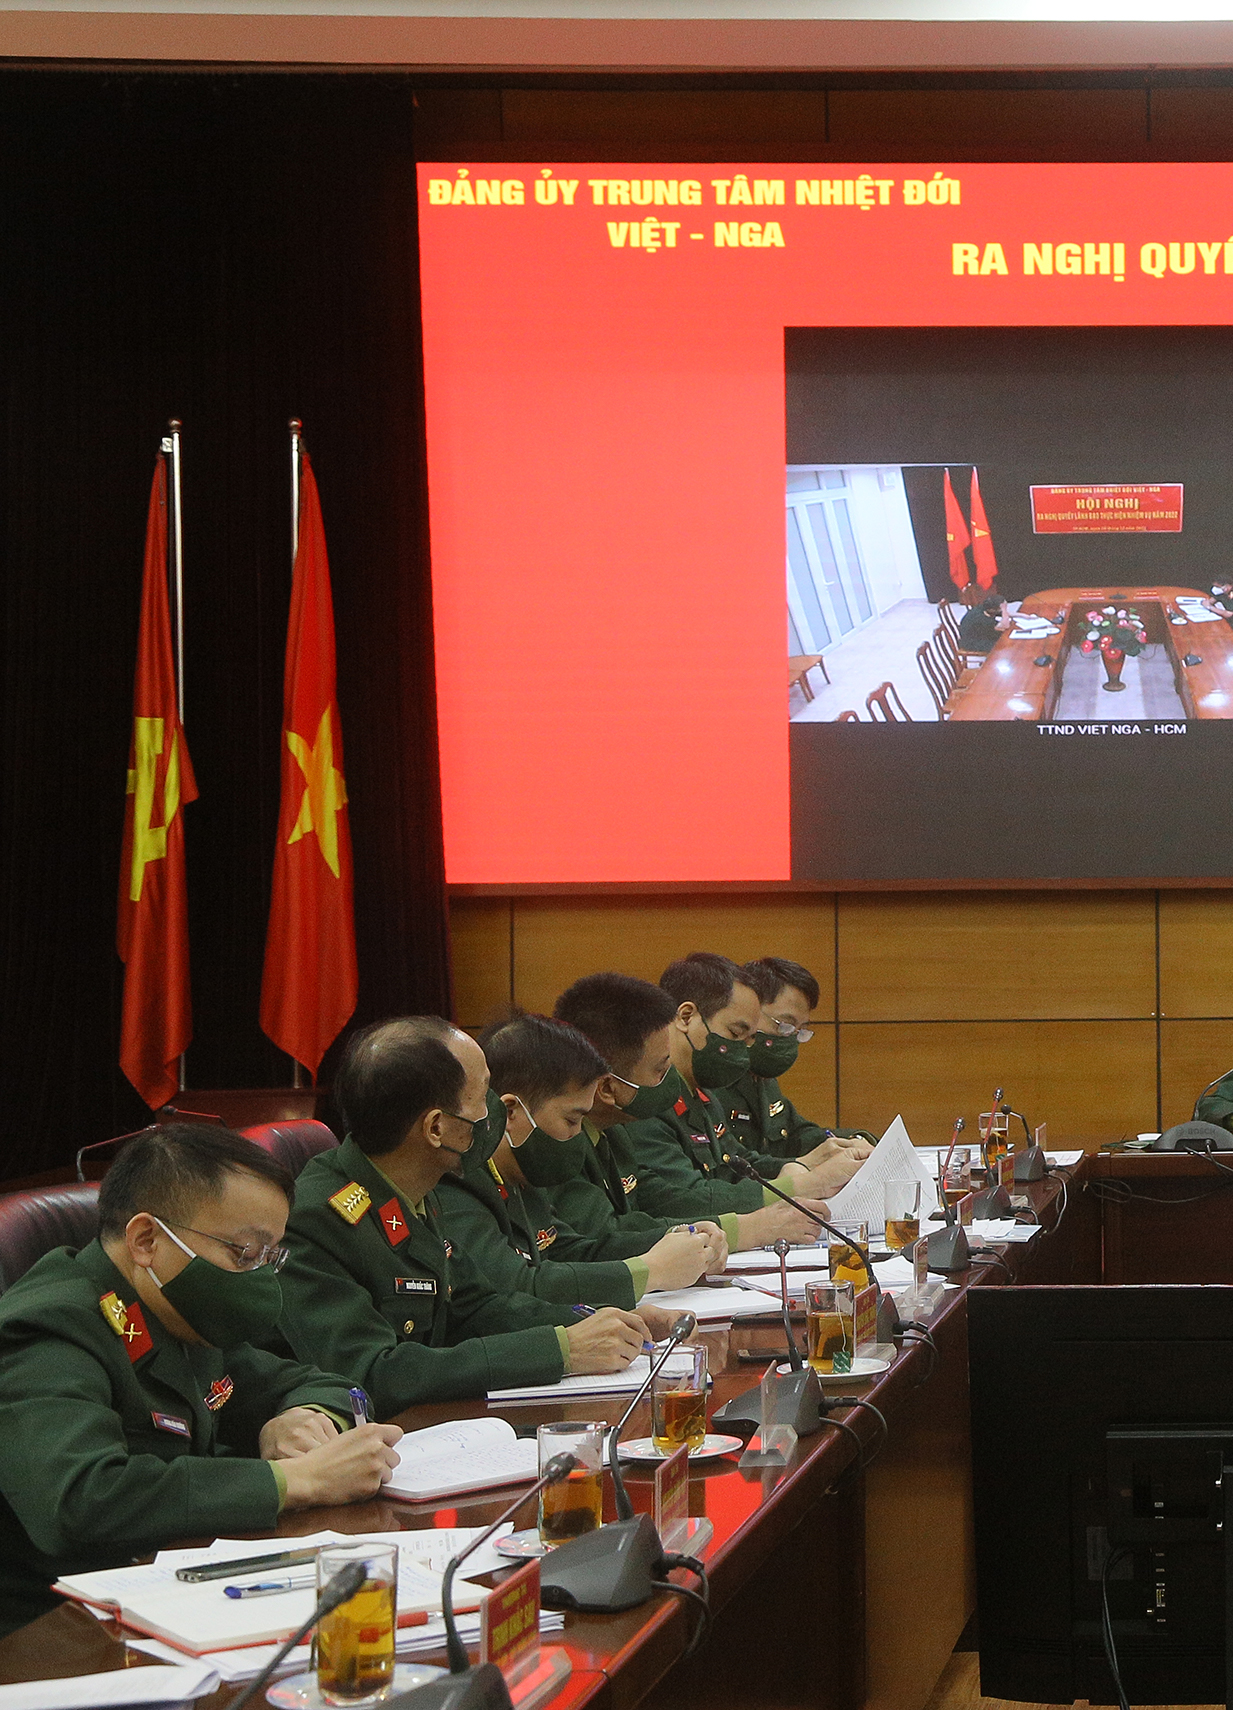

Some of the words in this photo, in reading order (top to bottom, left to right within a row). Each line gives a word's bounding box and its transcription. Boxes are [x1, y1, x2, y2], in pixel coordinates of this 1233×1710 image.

[428, 168, 525, 206] ĐẢNG
[535, 168, 580, 206] ỦY
[588, 179, 703, 206] TRUNG
[711, 174, 785, 206] TÂM
[795, 174, 895, 211] NHIỆT
[902, 171, 961, 206] ĐỚI
[606, 216, 682, 253] VIỆT
[714, 221, 786, 247] NGA
[952, 242, 1009, 275] RA
[1023, 242, 1126, 282] NGHỊ
[1104, 498, 1139, 510] NGHỊ
[1037, 725, 1075, 735] TTND
[1077, 725, 1109, 735] VIET
[1111, 725, 1141, 735] NGA
[1154, 724, 1187, 734] HCM
